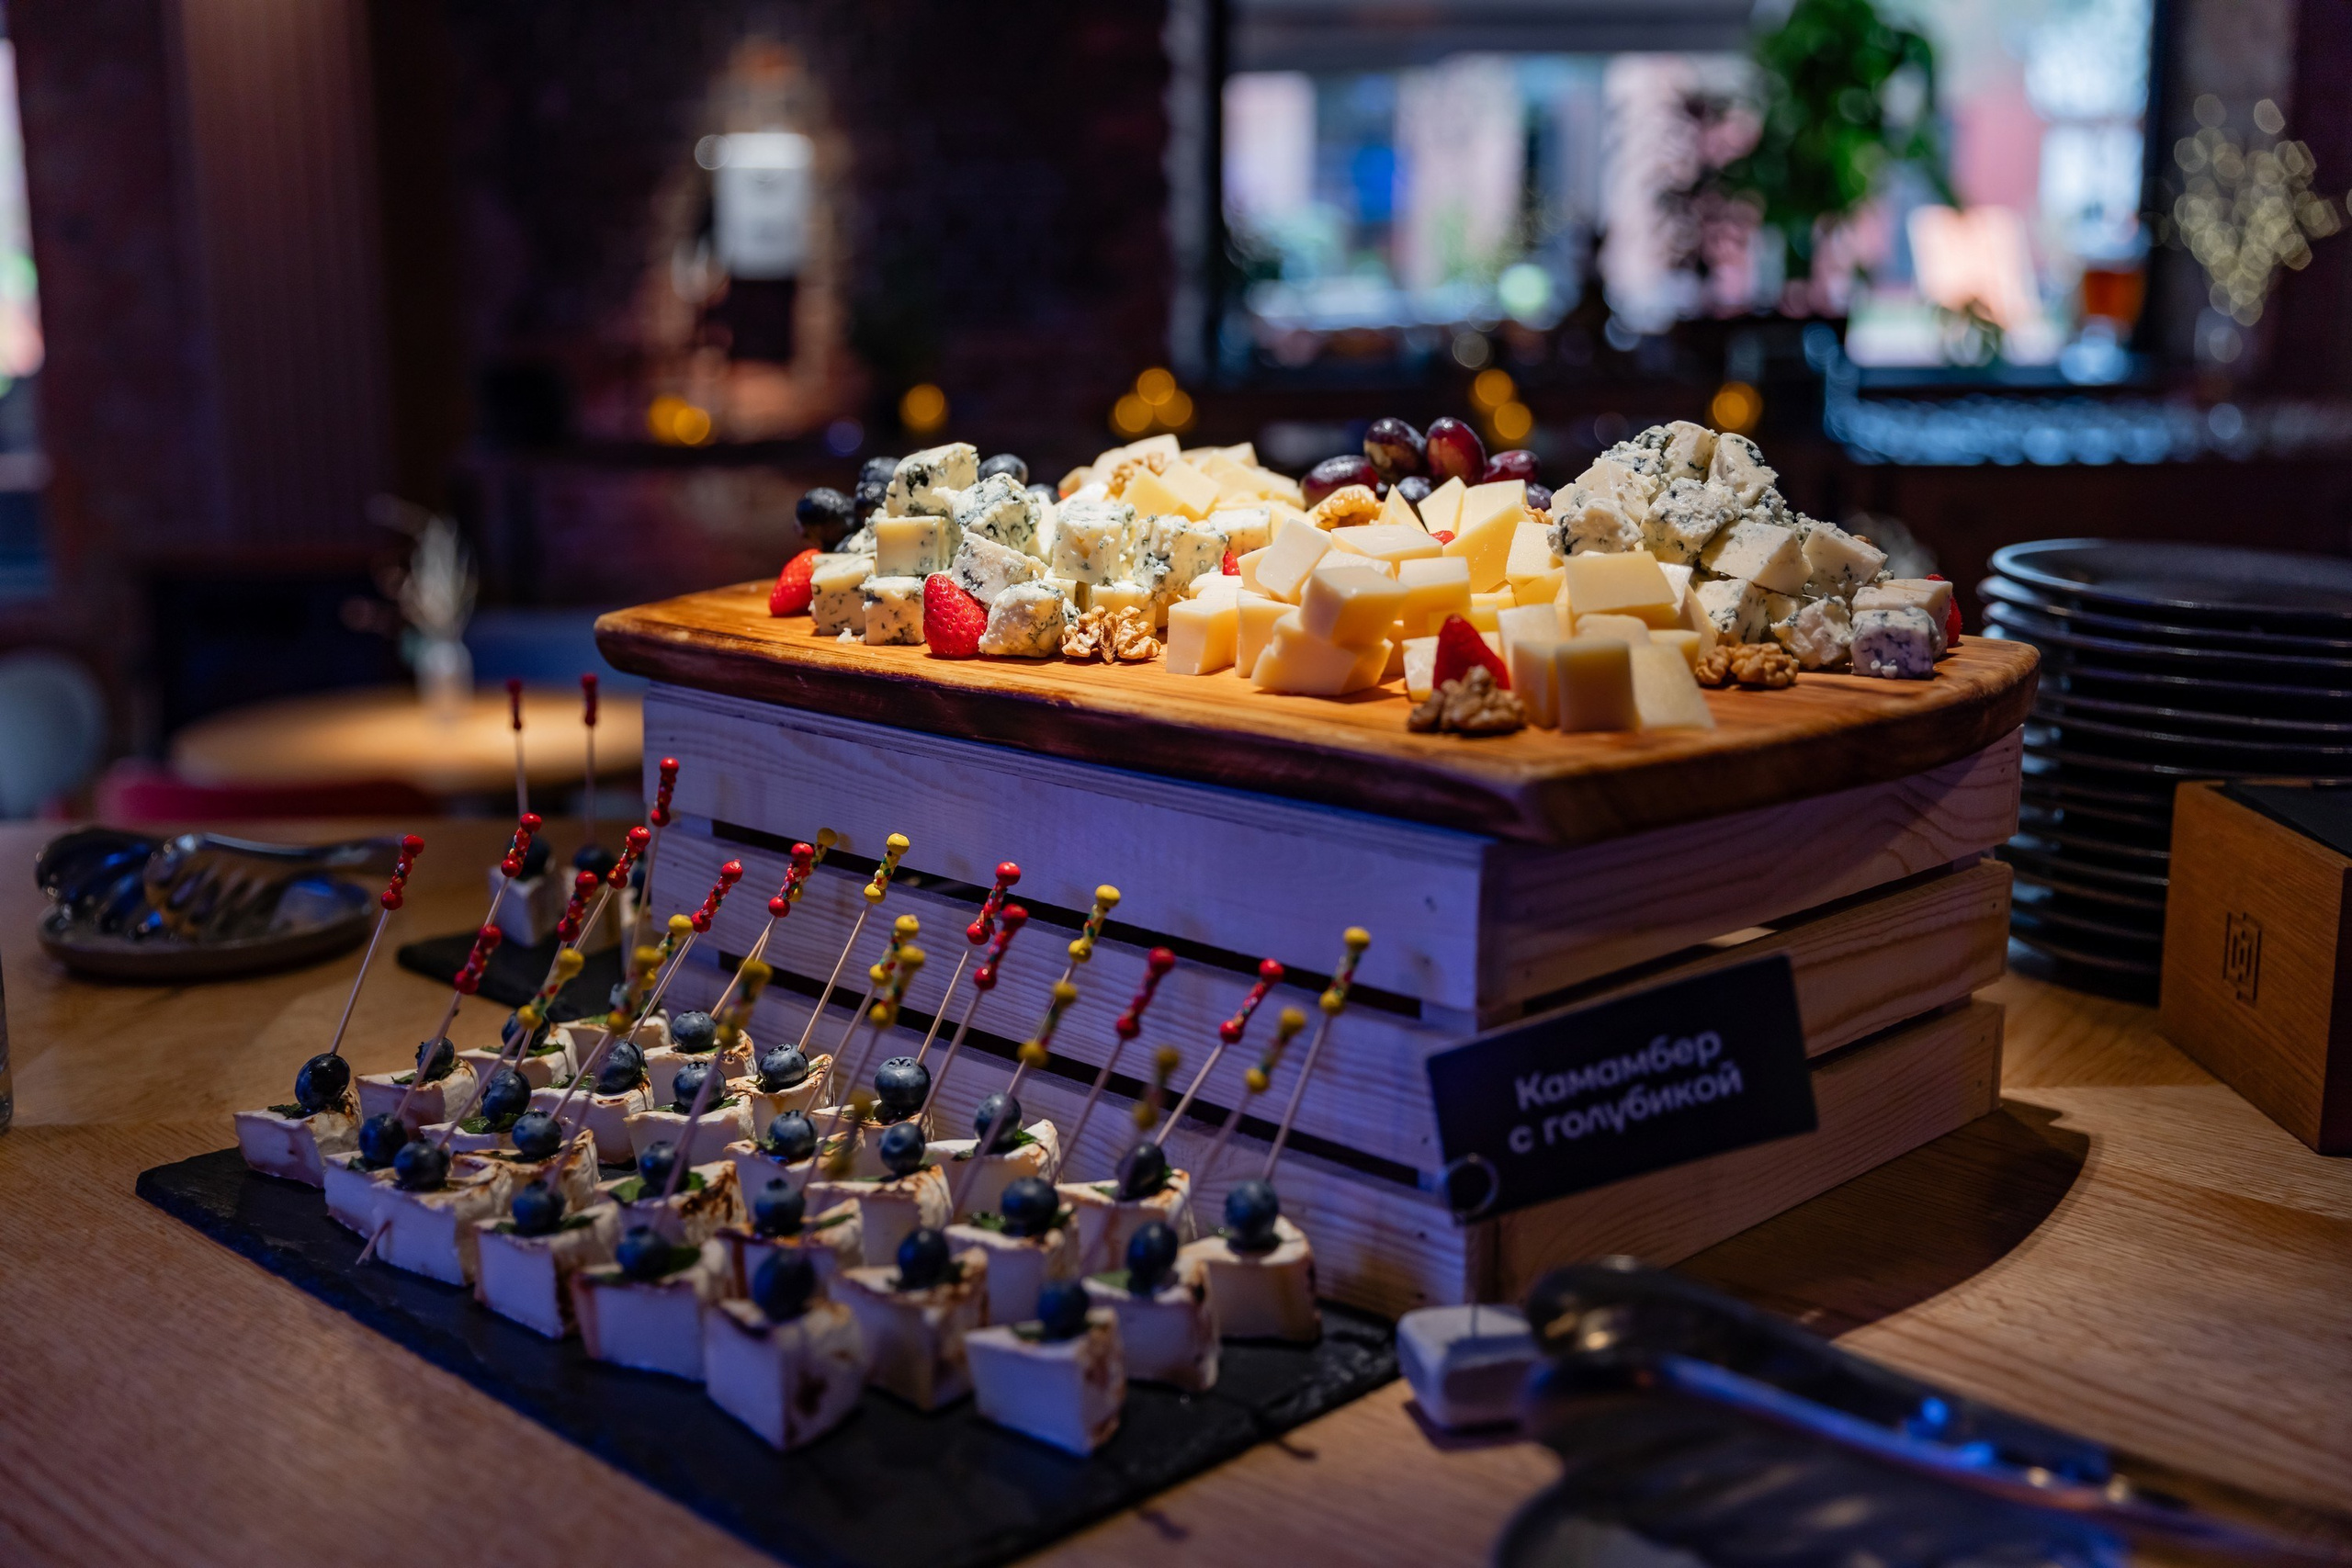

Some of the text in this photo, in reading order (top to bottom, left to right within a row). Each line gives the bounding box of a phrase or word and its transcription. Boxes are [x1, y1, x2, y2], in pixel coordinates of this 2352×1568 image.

[1508, 1060, 1744, 1154] с голубикой
[1514, 1030, 1723, 1111] Камамбер
